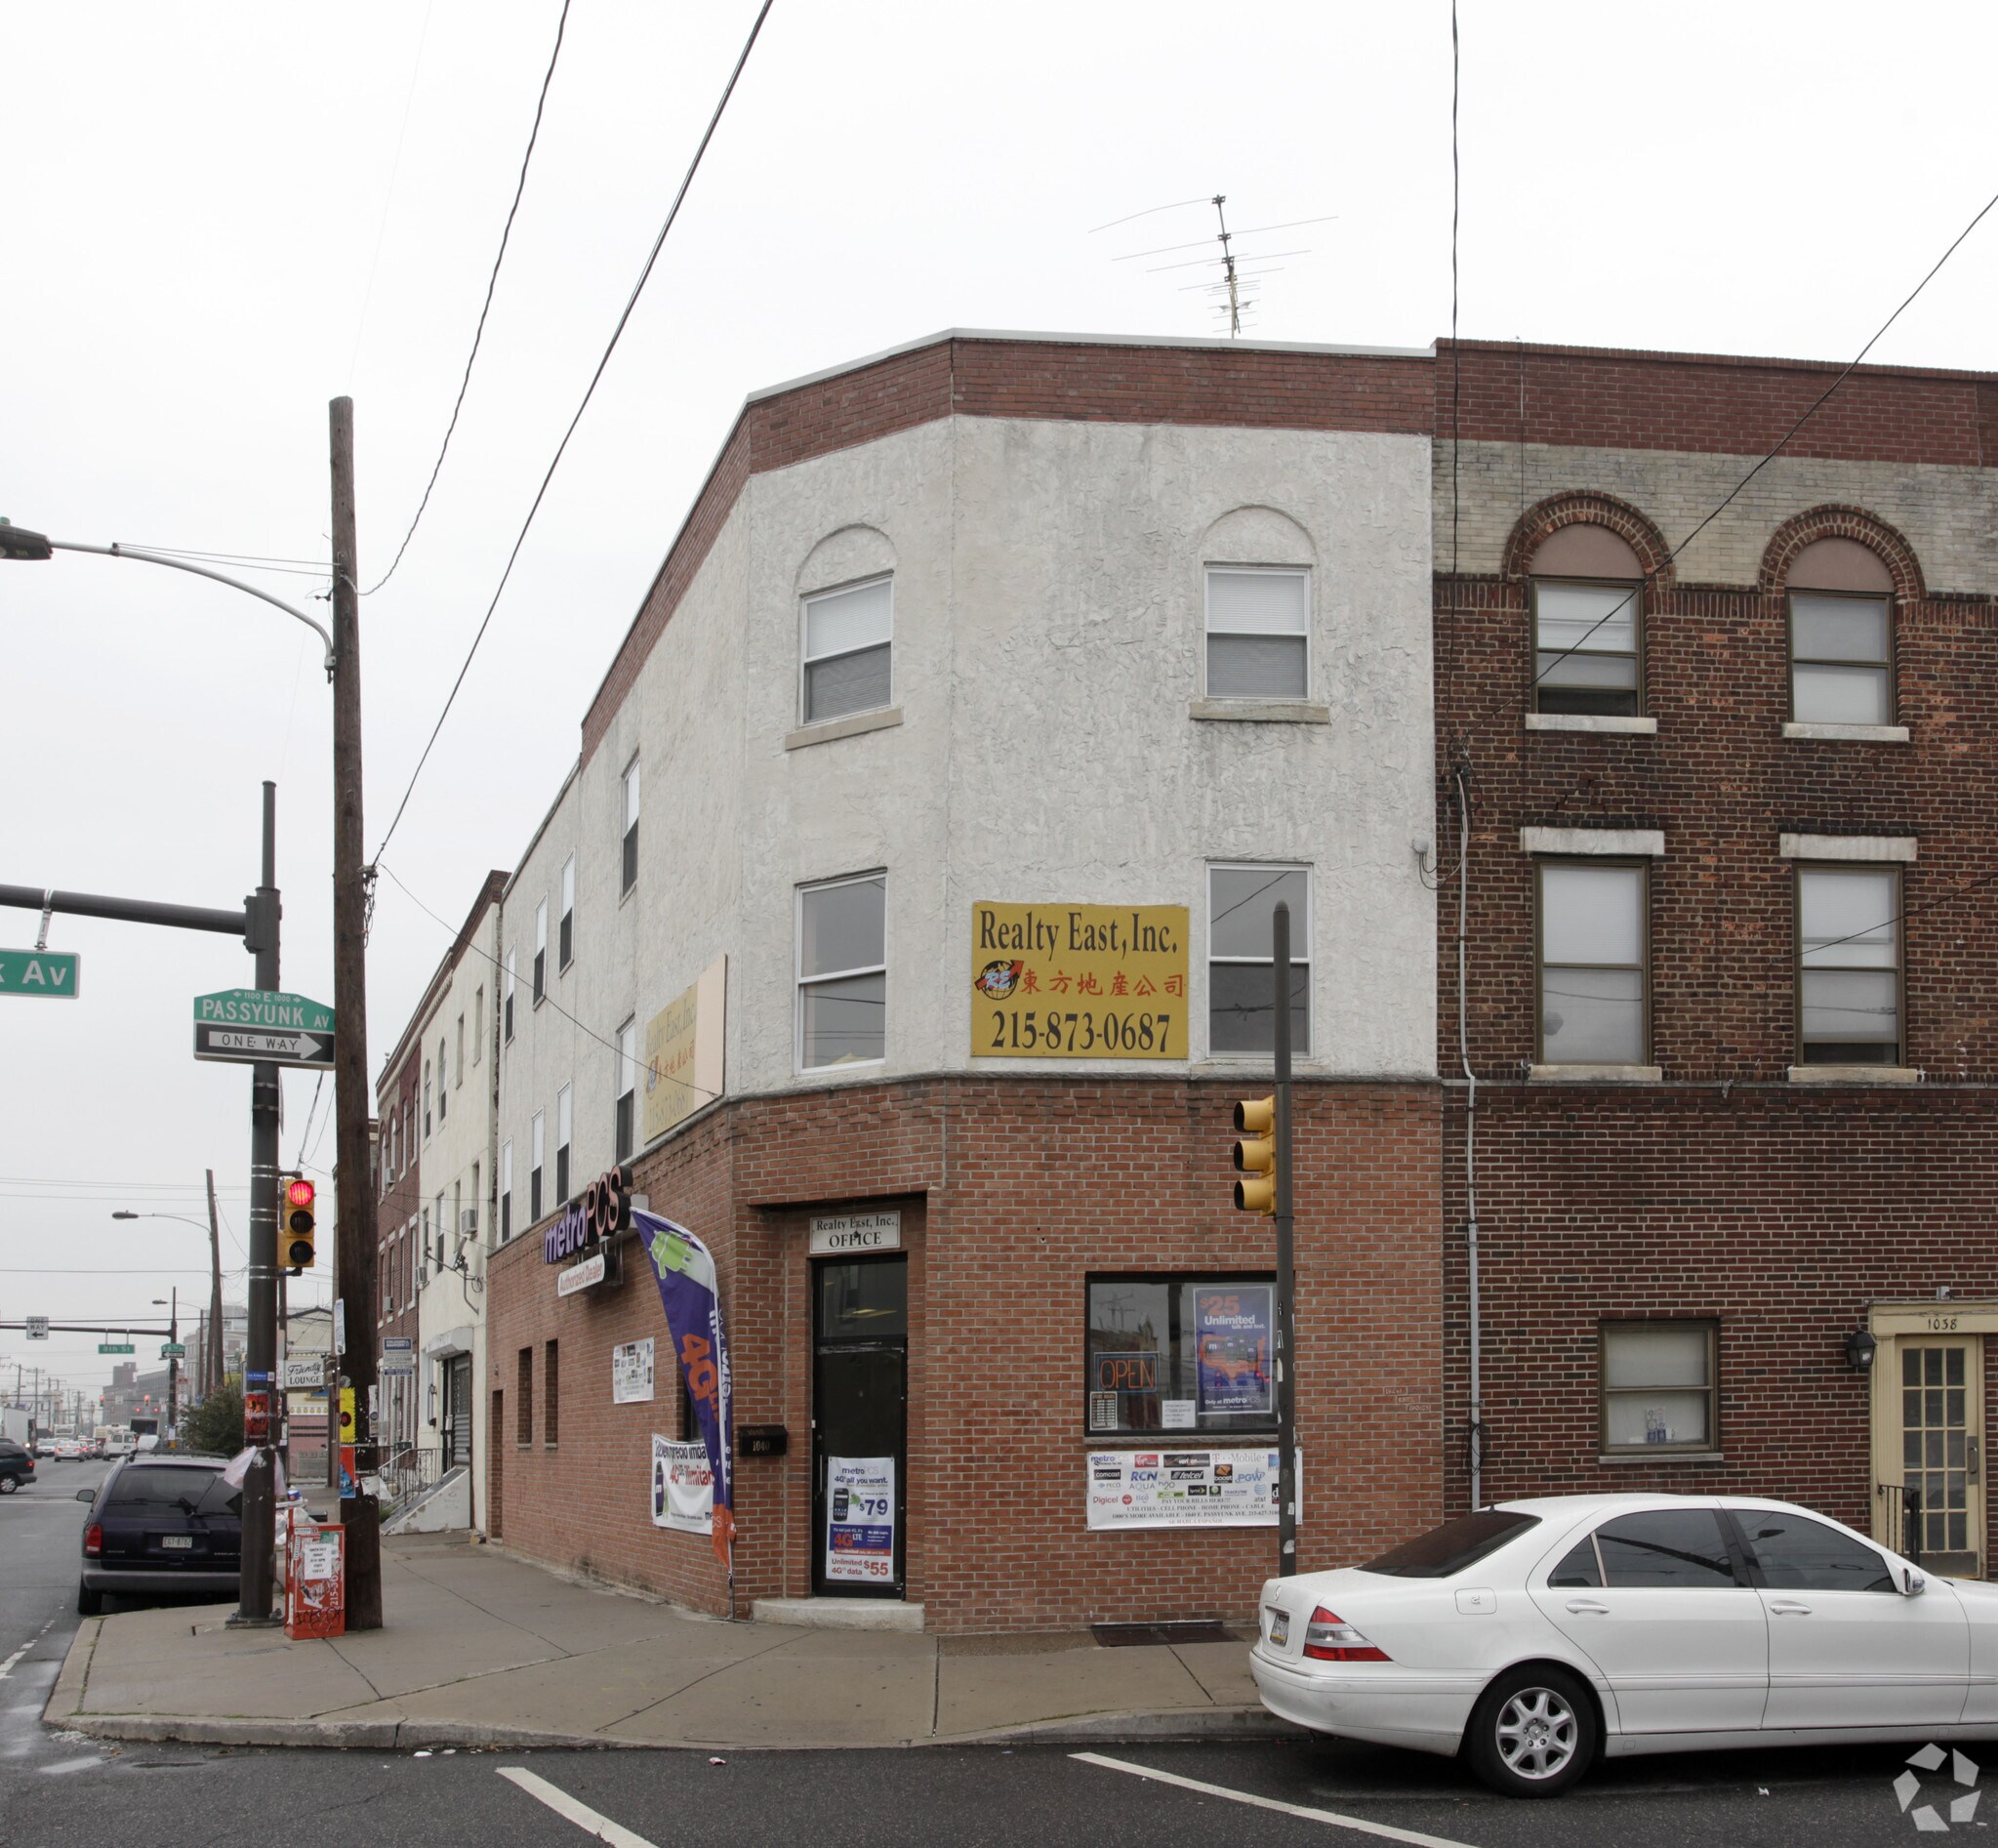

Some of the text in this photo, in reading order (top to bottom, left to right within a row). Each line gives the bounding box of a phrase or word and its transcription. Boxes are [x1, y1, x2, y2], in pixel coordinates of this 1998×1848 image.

[980, 910, 1059, 962] Realty
[1132, 914, 1177, 953] Inc.
[21, 960, 67, 986] Av
[1020, 968, 1184, 998] 東方地產公司
[264, 992, 271, 1002] E
[202, 999, 329, 1028] PASSYUNK AV
[992, 1010, 1170, 1052] 215-873-0687
[222, 1034, 298, 1050] ONE WAY
[544, 1165, 622, 1265] metroPCS
[816, 1215, 894, 1231] Realty East, Inc.
[829, 1231, 882, 1248] OFFICE
[1200, 1295, 1240, 1316] $25
[1204, 1315, 1255, 1326] Unlimited
[1928, 1318, 1957, 1331] 1038
[287, 1362, 323, 1376] Friendly
[681, 1334, 717, 1400] 4G
[1100, 1359, 1155, 1389] OPEN
[289, 1376, 321, 1384] LOUNGE
[753, 1440, 770, 1452] 1040
[1130, 1471, 1158, 1481] RCN
[859, 1499, 888, 1516] $79
[1093, 1497, 1118, 1505] Digicel
[835, 1533, 854, 1547] 4G
[864, 1560, 888, 1576] $55
